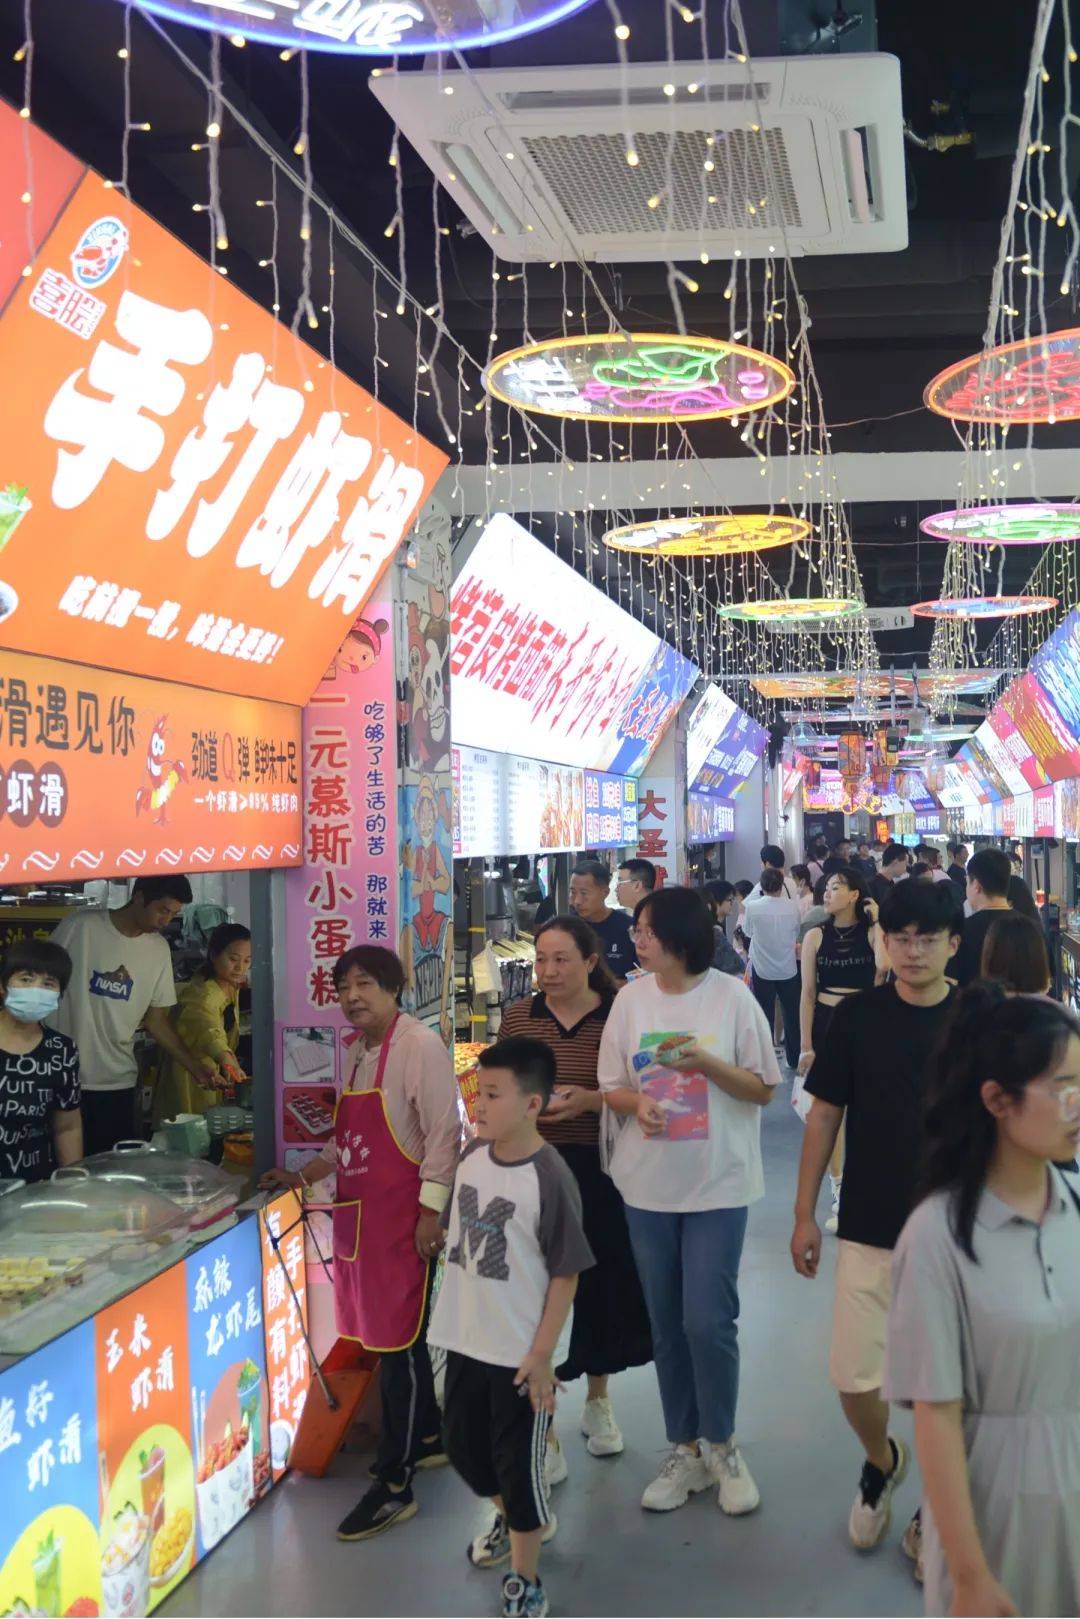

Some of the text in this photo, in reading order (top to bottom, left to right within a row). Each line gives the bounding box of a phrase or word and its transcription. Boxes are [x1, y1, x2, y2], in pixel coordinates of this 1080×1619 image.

[43, 288, 425, 615] 手打虾滑
[7, 771, 65, 818] 虾滑
[307, 696, 353, 1007] 一元慕斯小蛋糕
[363, 701, 389, 939] 吃够了生活的苦 那就来
[96, 976, 128, 996] NASA
[448, 1183, 516, 1282] M
